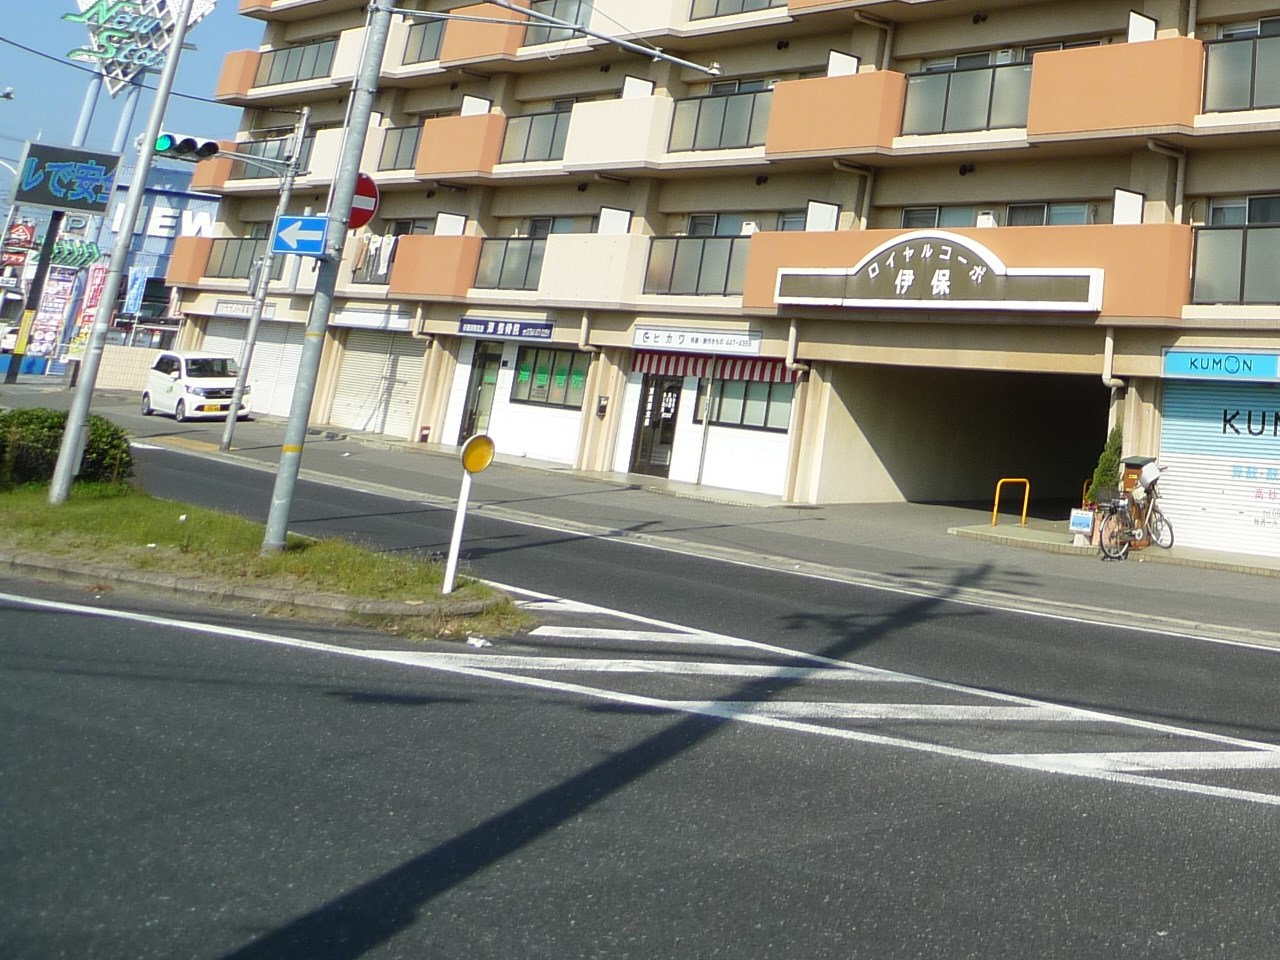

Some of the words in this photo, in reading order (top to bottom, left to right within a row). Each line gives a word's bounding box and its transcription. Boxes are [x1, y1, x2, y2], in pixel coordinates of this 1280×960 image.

[867, 243, 988, 284] ロイヤルコーポ
[894, 268, 951, 296] 伊保
[1189, 355, 1253, 374] KUMON
